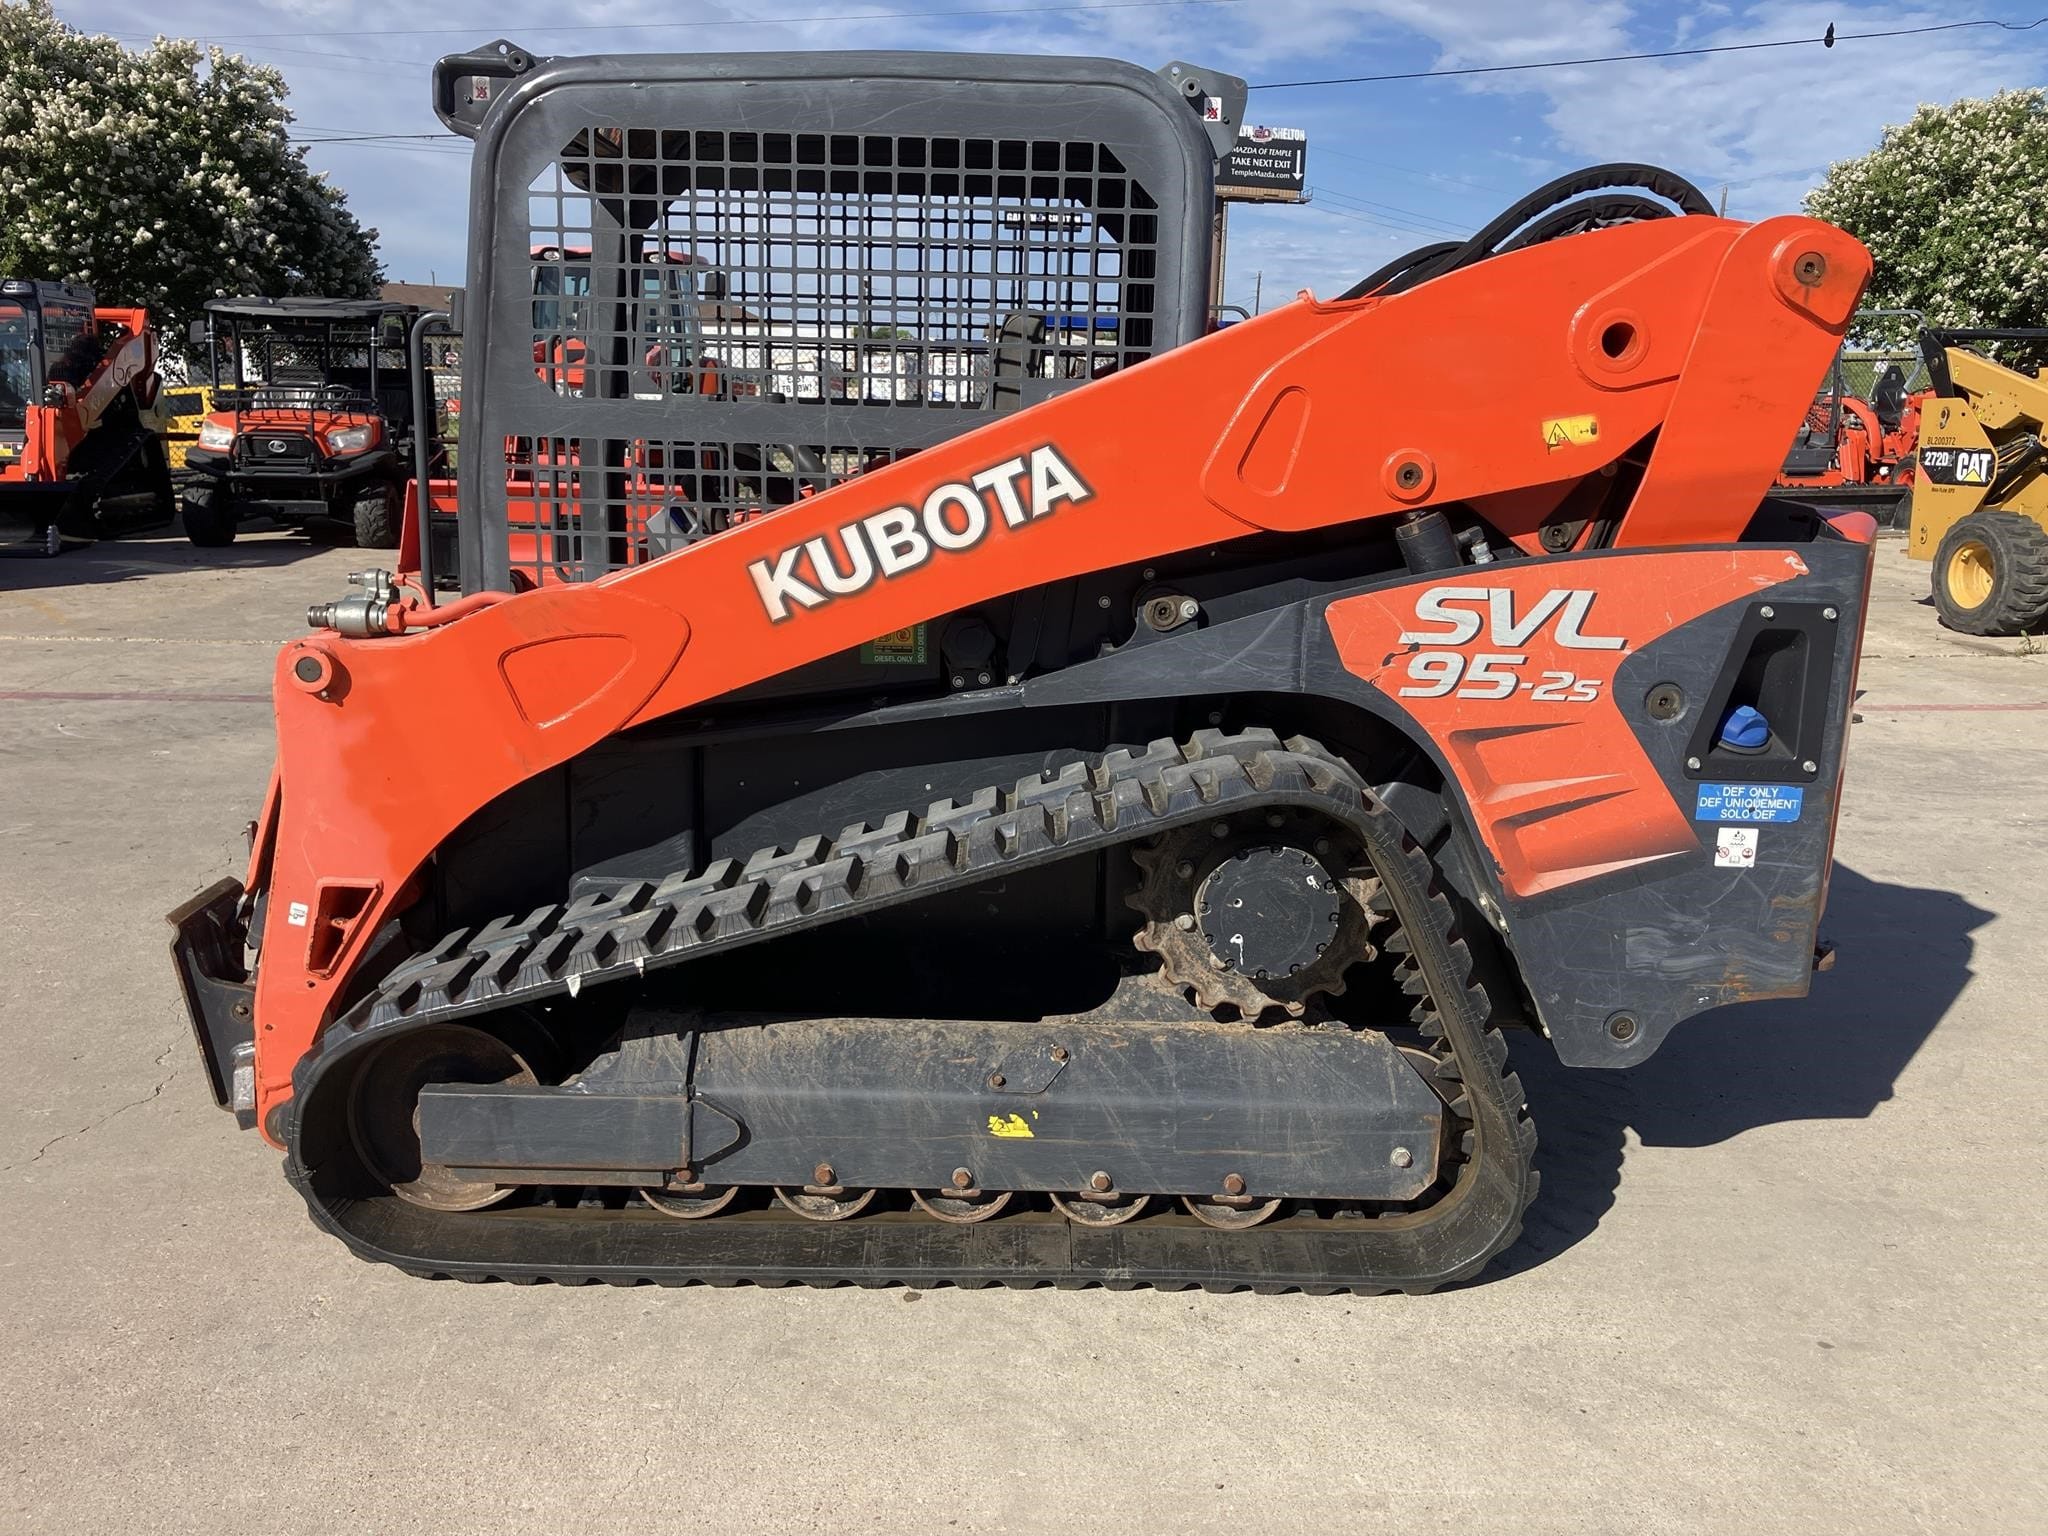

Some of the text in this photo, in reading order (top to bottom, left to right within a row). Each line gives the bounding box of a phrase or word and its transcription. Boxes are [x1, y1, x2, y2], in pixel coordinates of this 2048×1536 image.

[1272, 127, 1306, 141] SHELTON
[1232, 146, 1292, 157] MAZDA OF TEMPLE
[1231, 156, 1291, 169] TAKE NEXT EXIT
[1231, 168, 1290, 179] TempleMazda.com
[1956, 452, 1992, 482] CAT
[748, 445, 1093, 625] KUBOTA
[1398, 586, 1628, 650] SVL
[1722, 786, 1780, 798] DEF ONLY
[1699, 797, 1799, 810] DEF UNIQUEMENT
[1720, 809, 1776, 820] SOLO DEF
